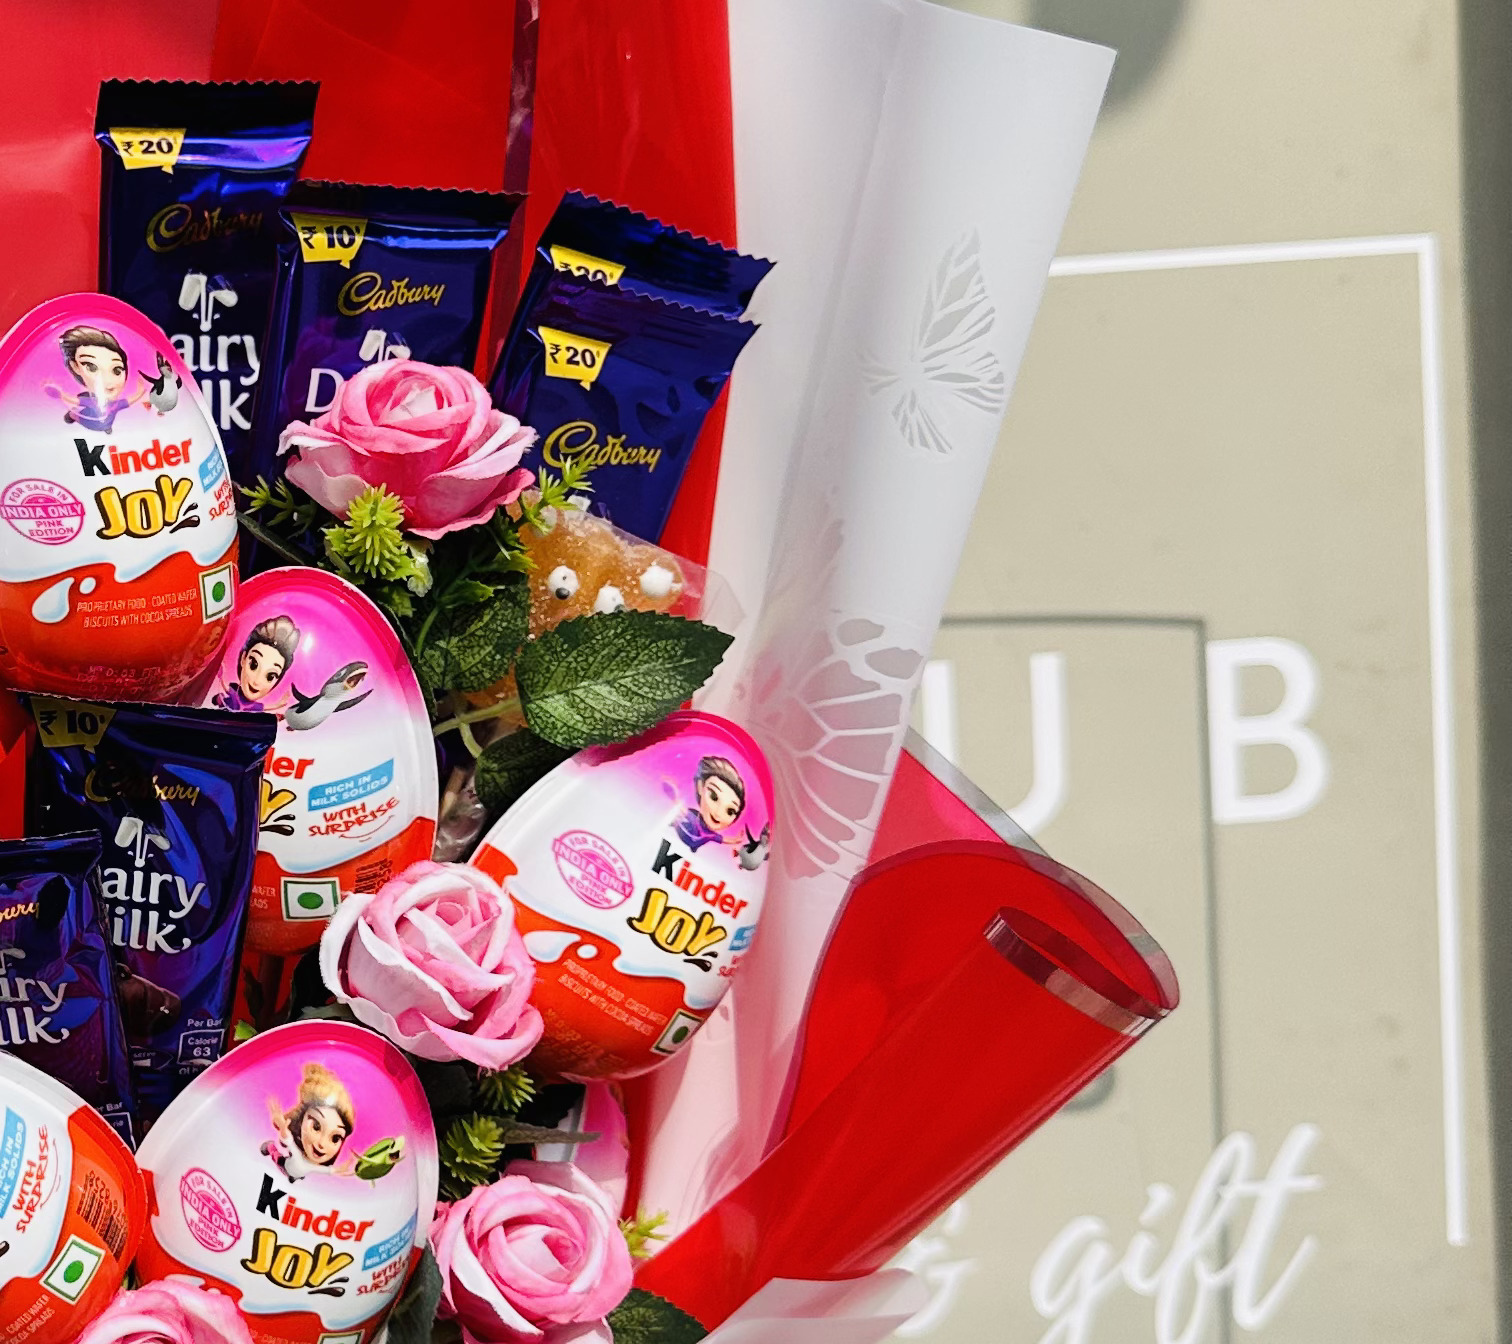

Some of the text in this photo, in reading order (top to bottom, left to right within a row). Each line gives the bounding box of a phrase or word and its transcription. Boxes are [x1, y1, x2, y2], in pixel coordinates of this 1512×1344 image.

[146, 203, 263, 254] Cadbury
[338, 271, 446, 317] Cadbury
[170, 333, 261, 387] airy
[201, 378, 252, 431] lk
[0, 504, 82, 518] INDIA ONLY
[9, 487, 25, 503] FOR
[25, 484, 55, 492] SALE
[94, 474, 194, 540] JOY
[28, 527, 74, 537] EDITION
[35, 519, 64, 528] PINK
[311, 776, 388, 808] MILK SOLIDS
[325, 774, 371, 796] RICH IN
[308, 796, 400, 838] SURPRISE
[323, 802, 366, 823] WITH
[100, 867, 207, 919] airy
[626, 887, 728, 957] JOY
[193, 1047, 211, 1057] 63
[5, 1136, 14, 1156] IN
[7, 1121, 25, 1180] SOLIDS
[12, 1160, 36, 1211] WITH
[16, 1124, 49, 1233] SURPRISE
[182, 1181, 240, 1239] INDIA ONLY
[240, 1227, 354, 1289] JOY
